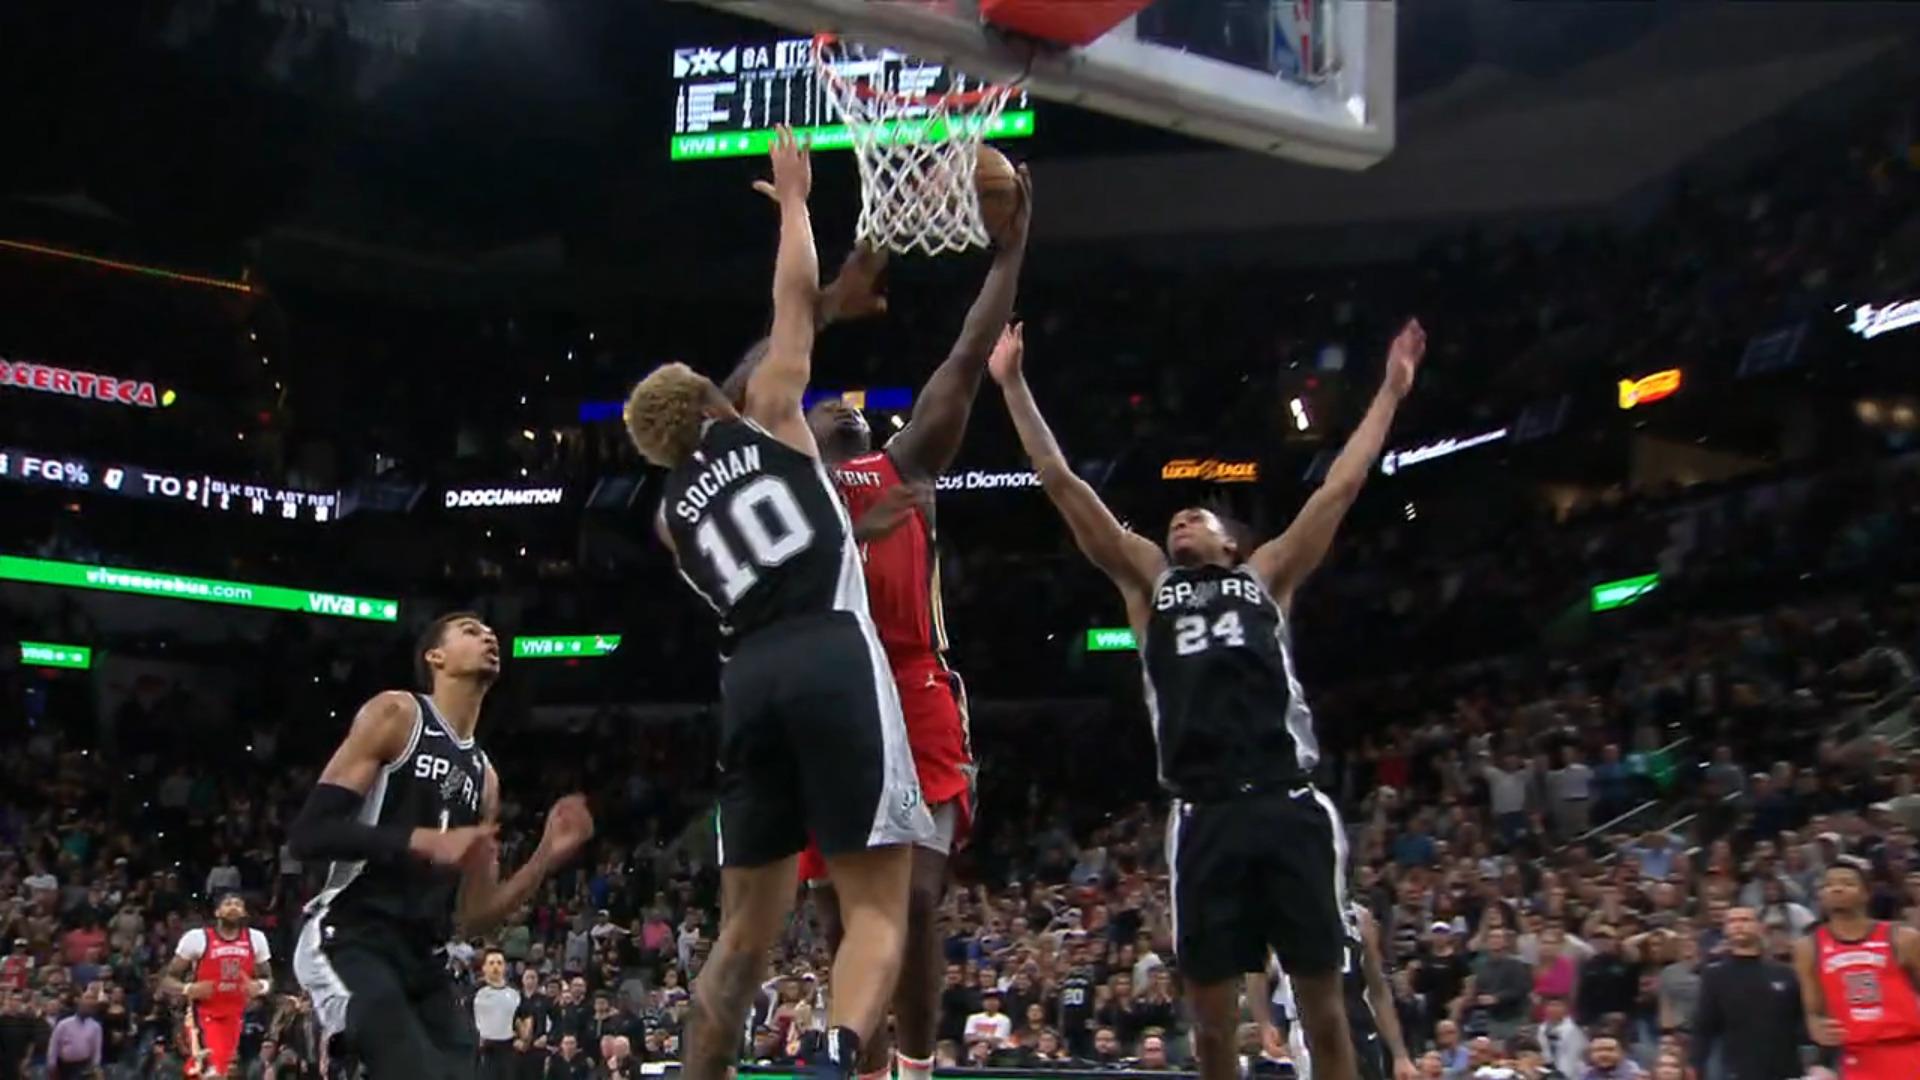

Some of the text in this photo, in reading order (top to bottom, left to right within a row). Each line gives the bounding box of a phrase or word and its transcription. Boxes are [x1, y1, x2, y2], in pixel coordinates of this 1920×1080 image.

[22, 456, 90, 485] FG%
[142, 473, 181, 496] TO
[458, 487, 563, 507] DOCUMATION
[676, 444, 762, 523] SOCHAN
[695, 475, 816, 606] 10
[1174, 610, 1245, 656] 24
